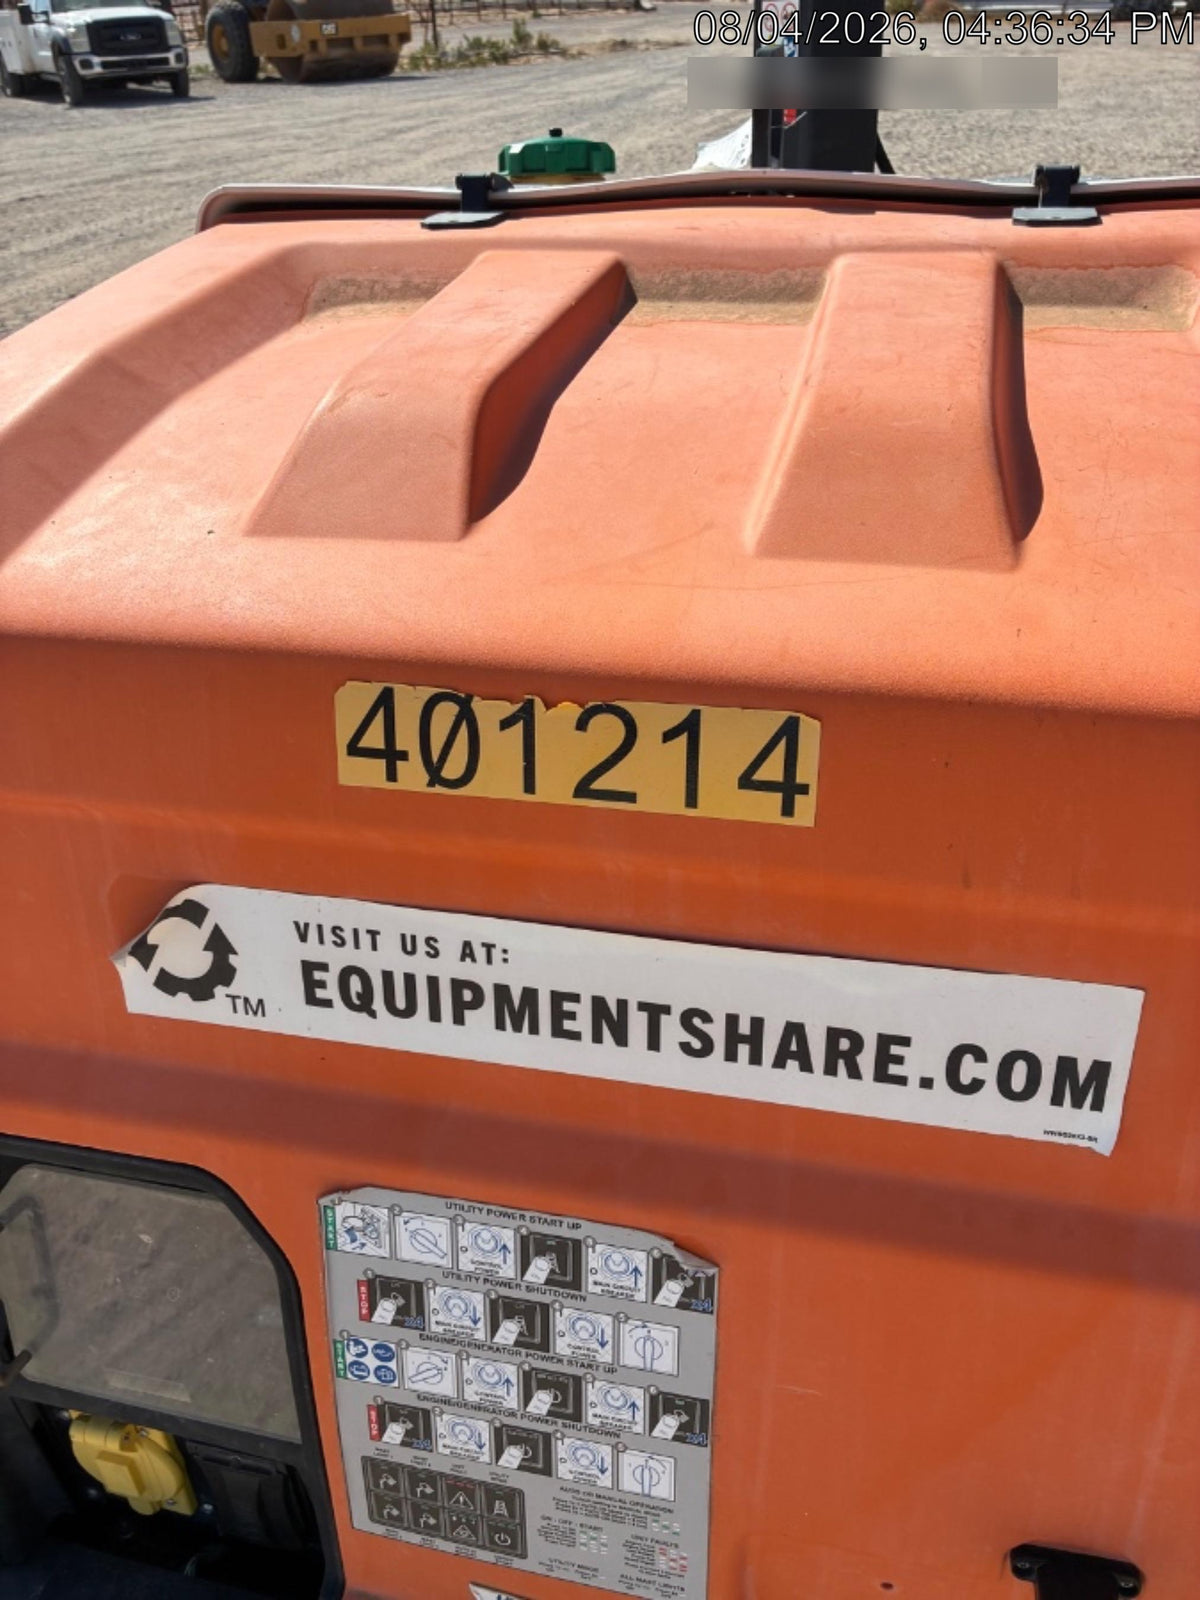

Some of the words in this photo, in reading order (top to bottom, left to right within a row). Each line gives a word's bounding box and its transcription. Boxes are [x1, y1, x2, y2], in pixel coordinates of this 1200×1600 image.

[346, 686, 811, 819] 401214
[293, 920, 381, 953] VISIT
[401, 933, 441, 959] US
[460, 941, 511, 966] AT:
[225, 993, 266, 1018] TM
[300, 959, 1112, 1113] EQUIPMENTSHARE.COM
[445, 1201, 484, 1215] UTILITY
[486, 1208, 527, 1222] POWER
[529, 1214, 564, 1229] START
[566, 1221, 582, 1231] UP
[442, 1270, 481, 1284] UTILITY
[483, 1277, 523, 1292] POWER
[525, 1284, 588, 1303] SHUTDOWN
[525, 1351, 564, 1366] POWER
[566, 1358, 601, 1373] START
[603, 1366, 618, 1375] UP
[520, 1412, 558, 1428] POWER
[561, 1421, 622, 1439] SHUTDOWN
